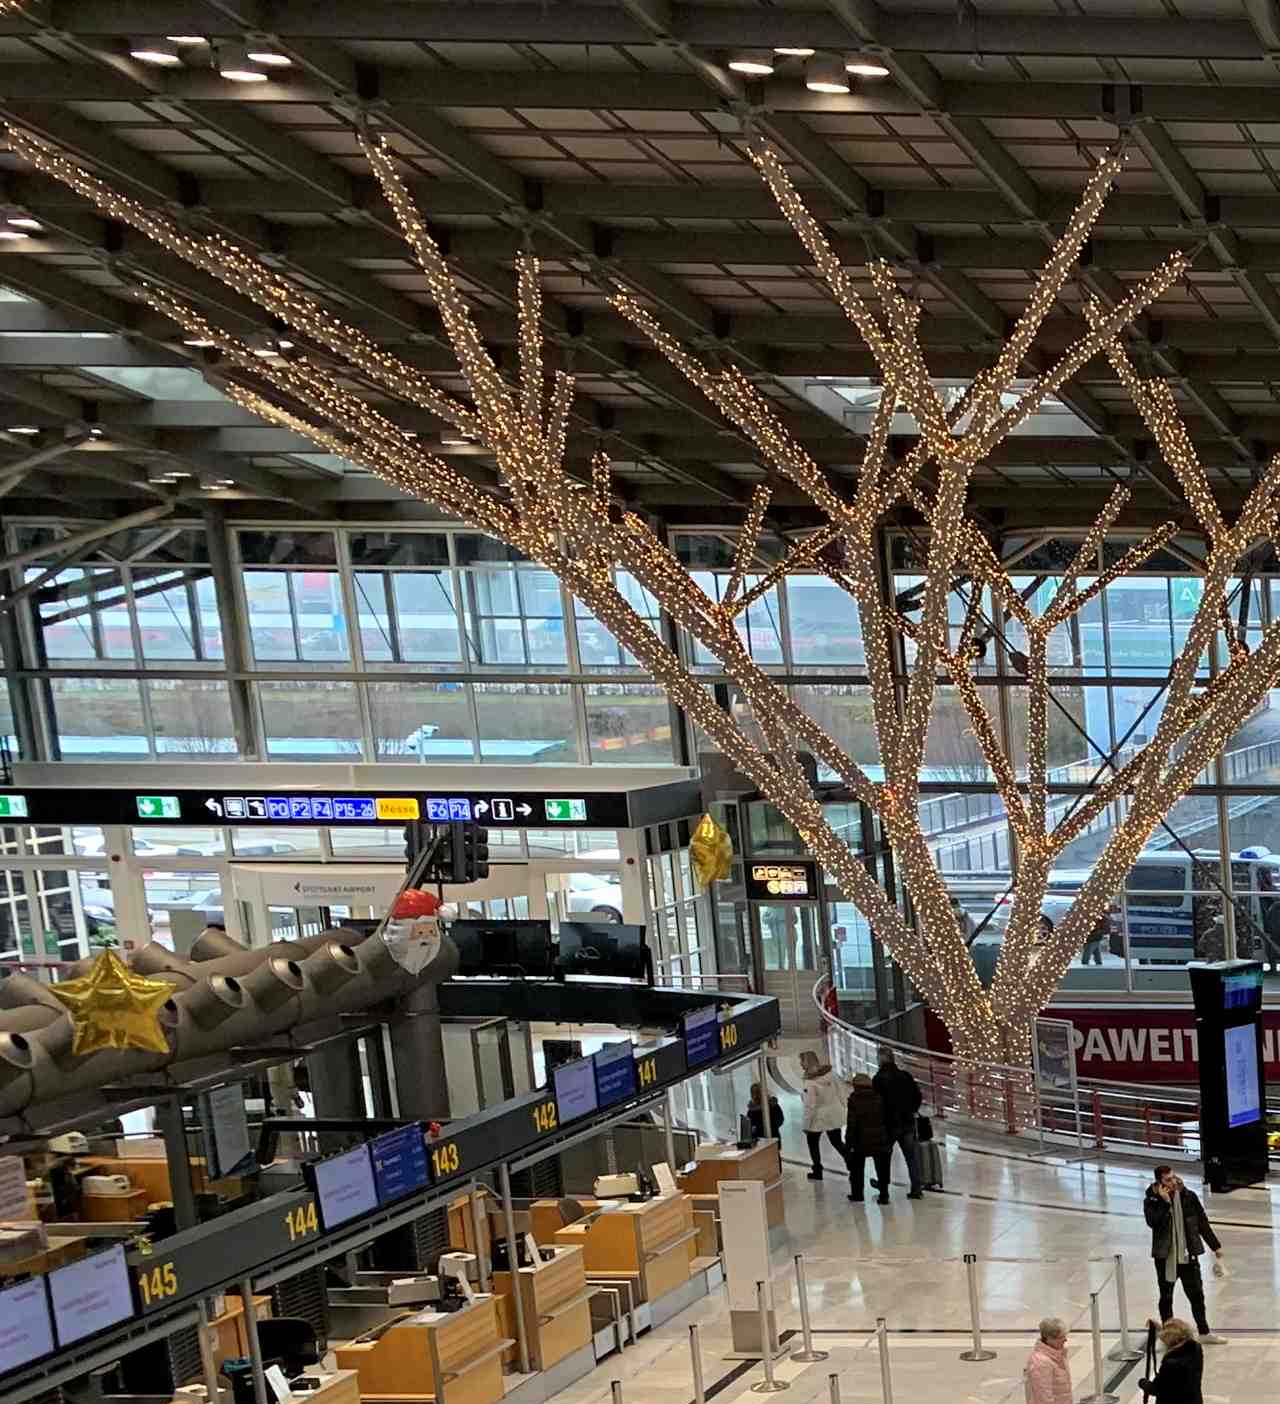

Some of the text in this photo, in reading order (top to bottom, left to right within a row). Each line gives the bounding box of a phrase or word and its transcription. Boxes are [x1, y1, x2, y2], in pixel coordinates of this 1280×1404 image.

[292, 800, 311, 817] P2
[313, 800, 332, 817] P4
[429, 800, 470, 817] P6 P14
[720, 1023, 738, 1050] 140
[638, 1060, 657, 1087] 141
[532, 1102, 557, 1133] 142
[432, 1143, 460, 1177] 143
[284, 1202, 319, 1243] 144
[138, 1262, 178, 1305] 145
